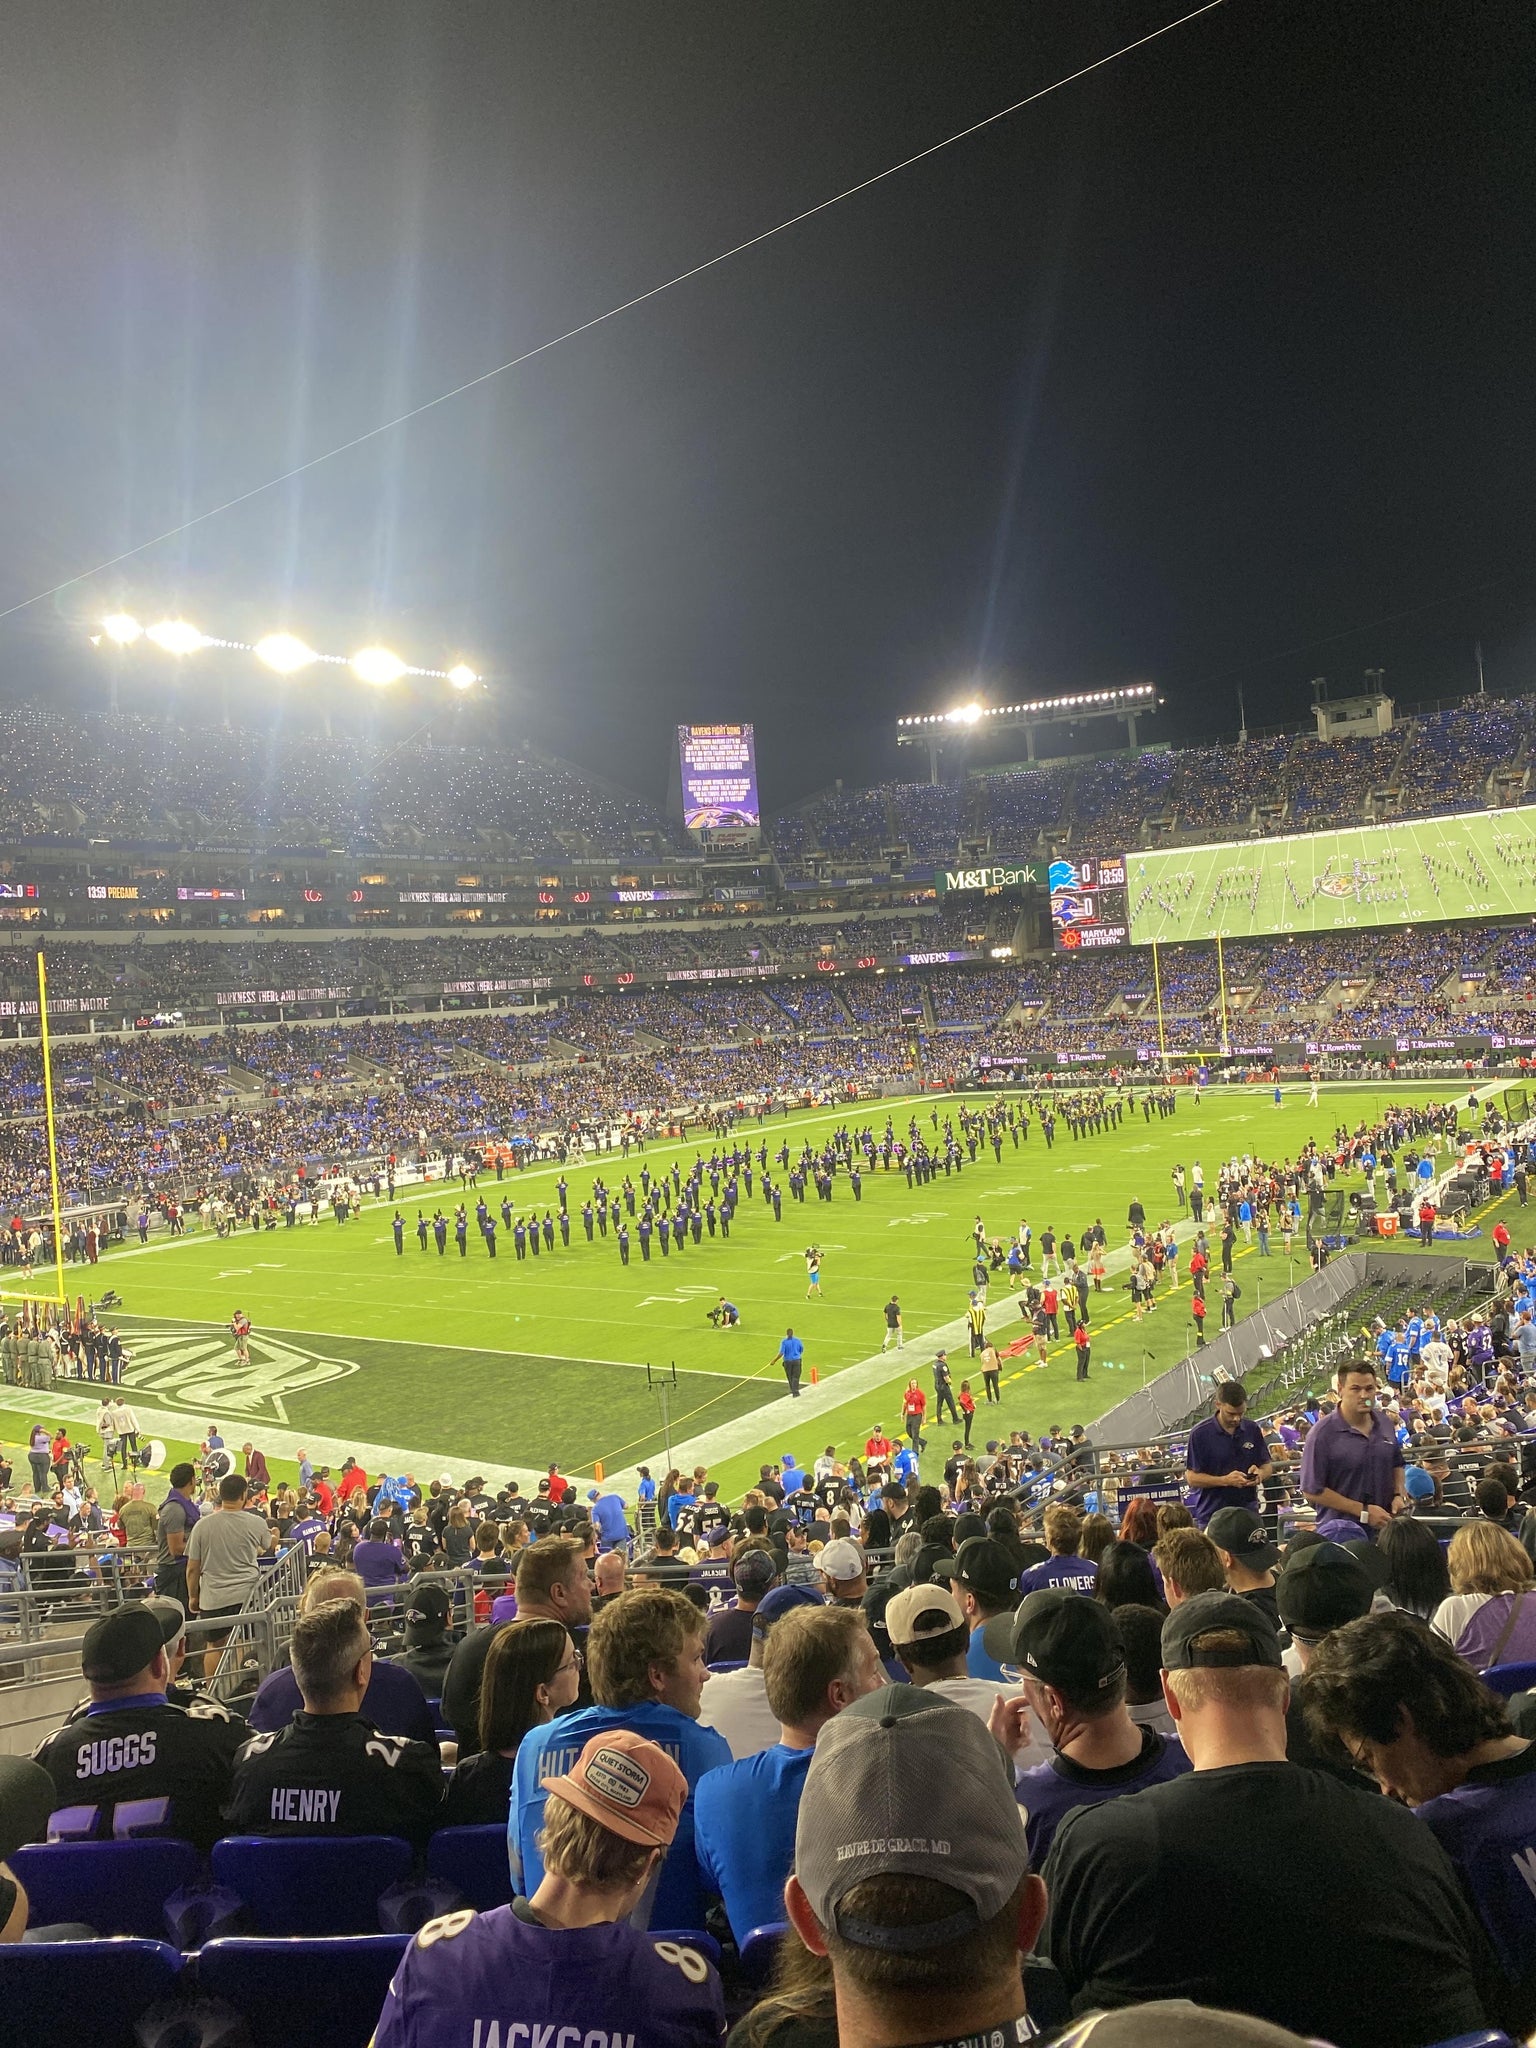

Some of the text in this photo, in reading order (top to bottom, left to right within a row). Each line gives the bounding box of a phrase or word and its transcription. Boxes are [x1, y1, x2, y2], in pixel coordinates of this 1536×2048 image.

[1100, 859, 1122, 868] PREGAME
[945, 864, 1037, 891] M&T Bank
[1082, 864, 1090, 883] 0
[1099, 868, 1124, 885] 13:59
[17, 885, 24, 898] 0
[88, 886, 139, 899] 13:59 PREGAME
[400, 892, 430, 902] DARKNESS
[618, 890, 655, 902] RAVENS
[1084, 898, 1093, 917] 0
[1080, 928, 1125, 939] MARYLAND
[908, 952, 950, 965] RAVENS
[666, 970, 698, 981] DARKNESS
[700, 968, 716, 979] THERE
[717, 968, 730, 978] AND
[444, 981, 476, 994] DARKNESS
[476, 980, 494, 992] THERE
[494, 980, 507, 991] AND
[217, 990, 256, 1004] DARKNESS
[258, 990, 280, 1002] THERE
[280, 990, 296, 1002] AND
[298, 988, 327, 1001] NOTHING
[19, 1002, 38, 1015] AND
[46, 998, 78, 1013] OTHING
[1383, 1220, 1392, 1230] G
[826, 1490, 835, 1506] 8
[302, 1525, 322, 1536] HAMILTON
[676, 1513, 694, 1533] 52
[412, 1542, 421, 1556] 8
[1049, 1575, 1096, 1591] FLOWERS
[76, 1731, 158, 1779] SUGGS
[600, 1754, 644, 1784] QUIET STORM
[271, 1788, 341, 1822] HENRY
[837, 1840, 870, 1860] HAVRE
[871, 1839, 886, 1854] DE
[931, 1840, 951, 1854] MD
[416, 1908, 477, 1949] 8
[654, 1941, 708, 1984] 8
[472, 2018, 636, 2048] JACKSON
